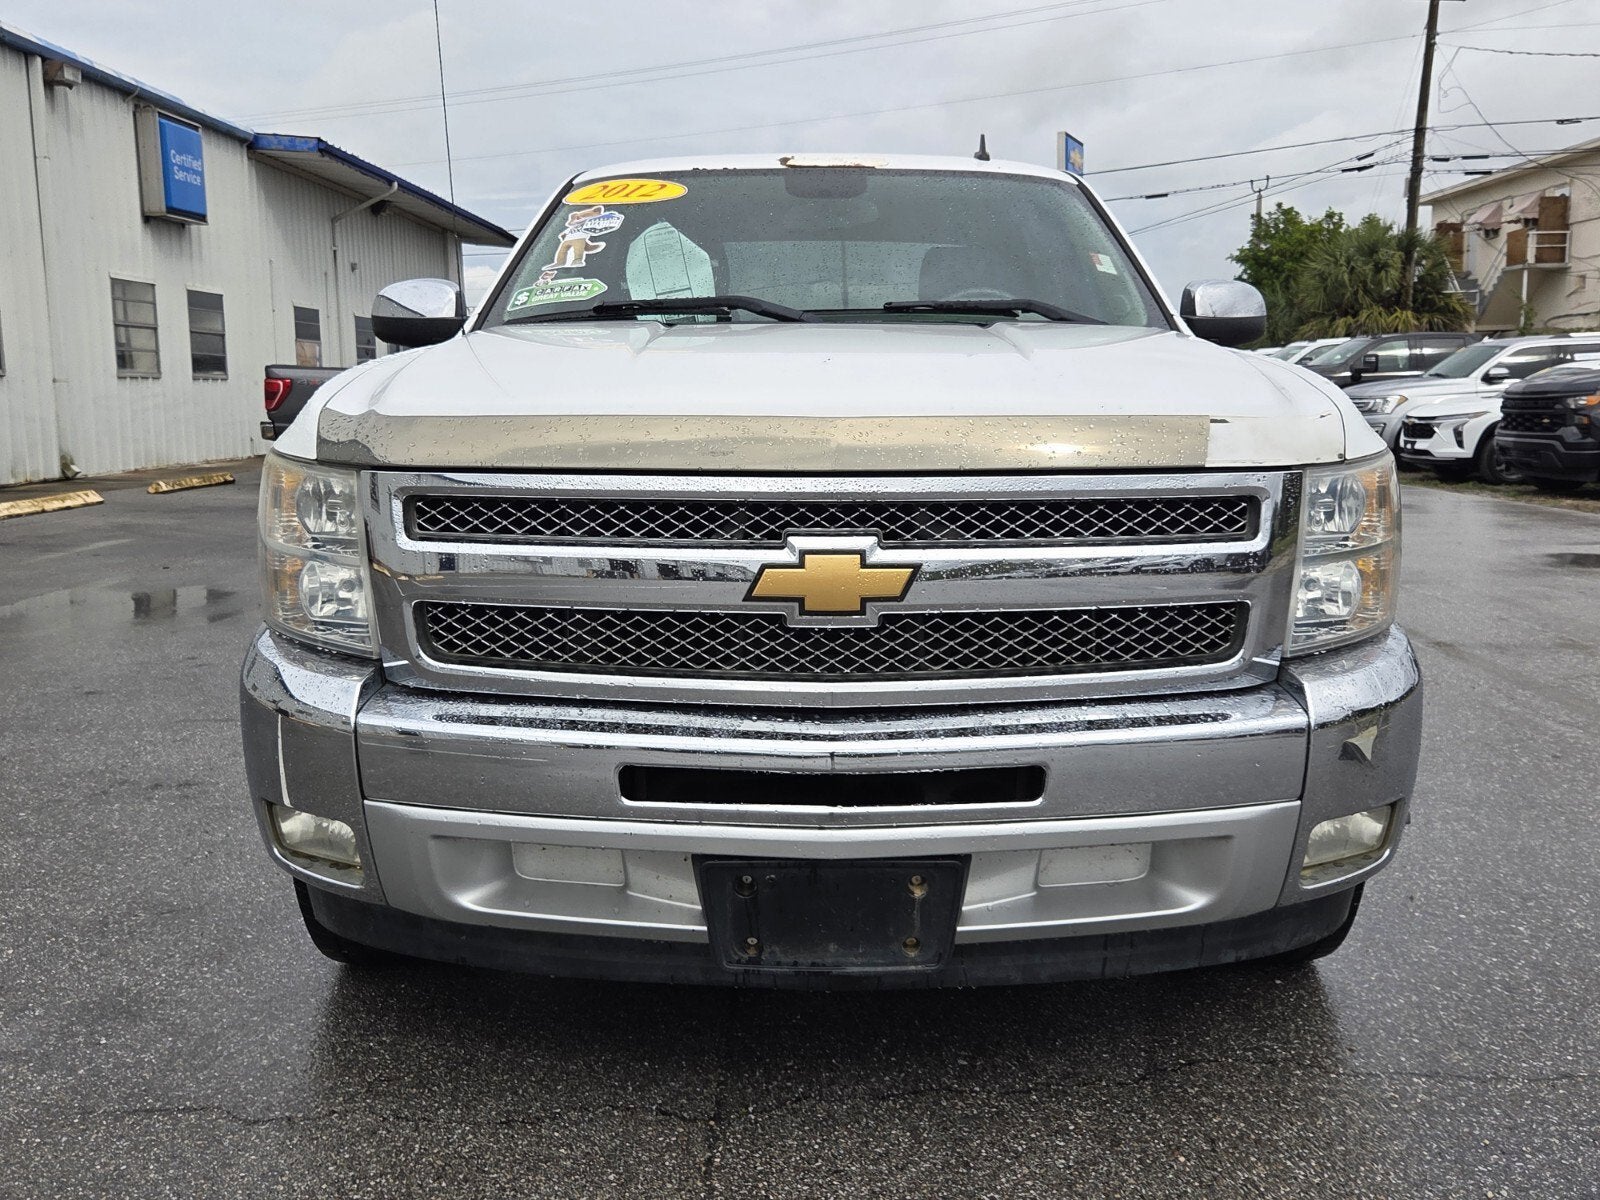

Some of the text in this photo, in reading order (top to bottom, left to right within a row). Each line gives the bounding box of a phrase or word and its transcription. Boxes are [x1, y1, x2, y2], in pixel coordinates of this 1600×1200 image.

[170, 149, 202, 171] Certified
[173, 165, 201, 186] Service
[579, 183, 668, 201] 2012
